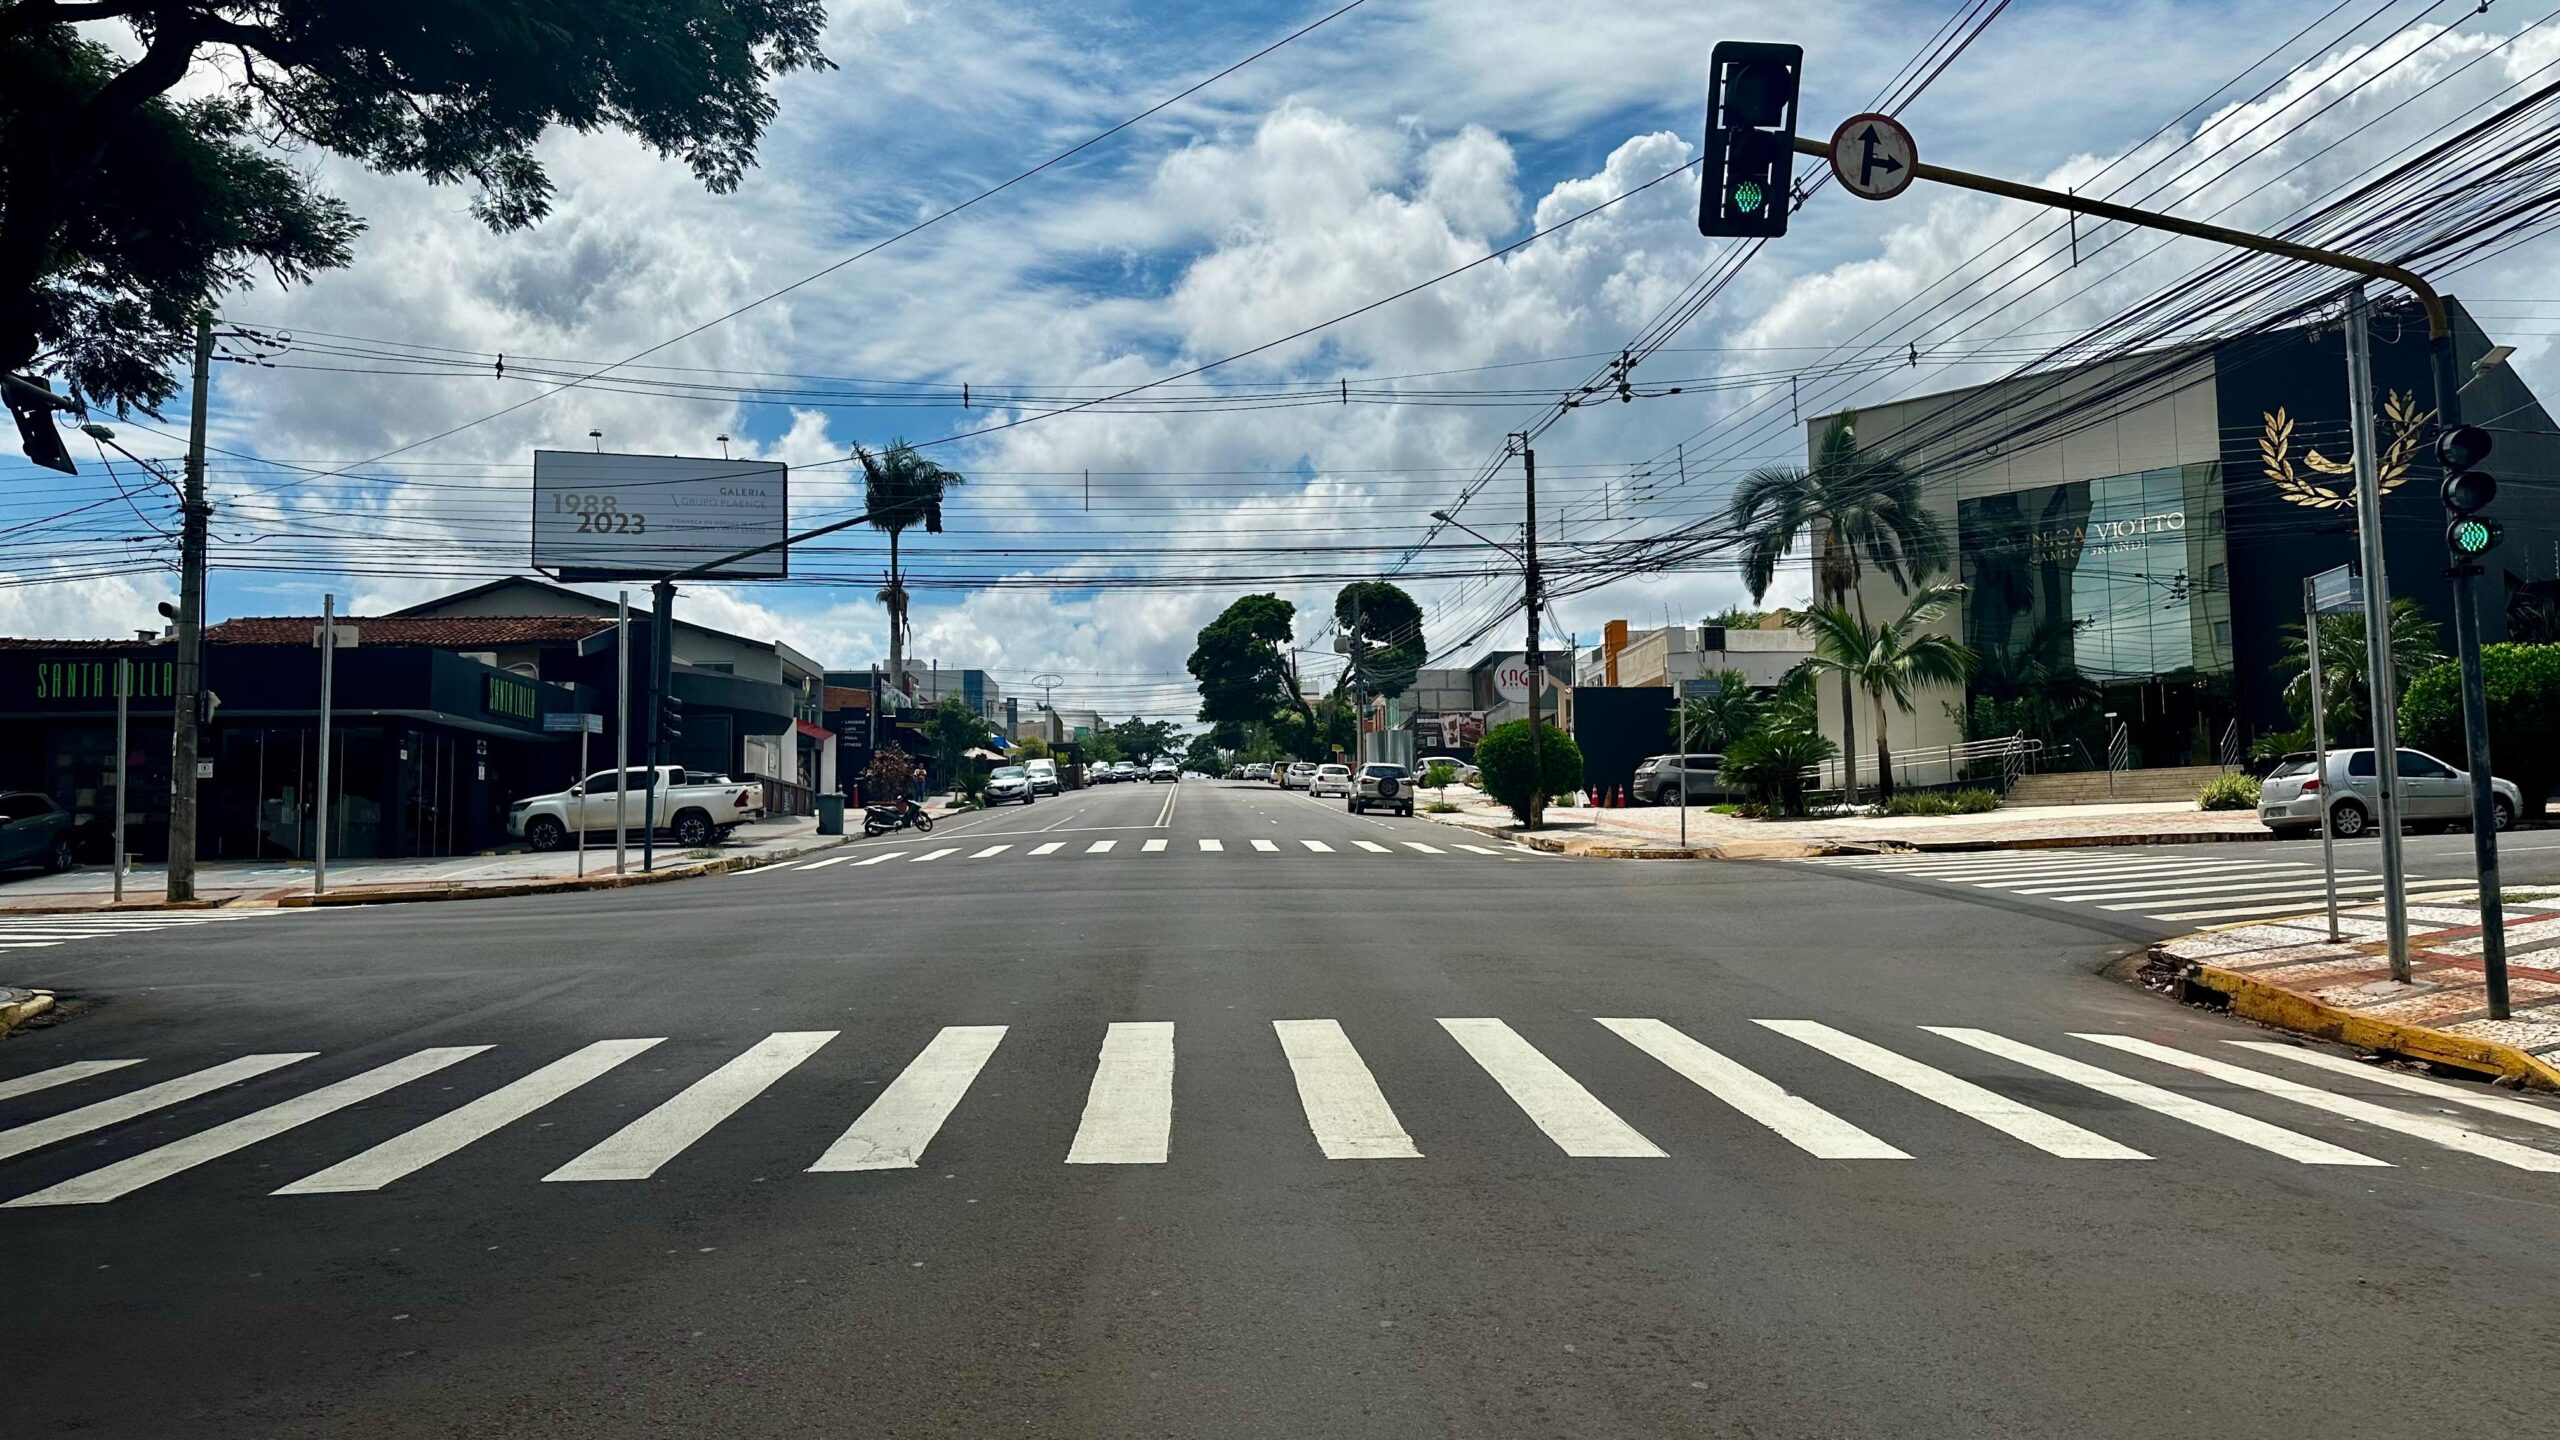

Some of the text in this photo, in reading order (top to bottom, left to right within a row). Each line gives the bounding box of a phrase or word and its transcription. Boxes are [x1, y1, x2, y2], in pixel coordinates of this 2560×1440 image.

[552, 493, 617, 515] 1988
[680, 497, 718, 507] GRUPO
[720, 487, 766, 497] GALERIA
[576, 511, 645, 535] 2023
[2094, 511, 2186, 541] VIOTTO
[37, 662, 103, 698] SANTA
[490, 678, 513, 713] SANTA
